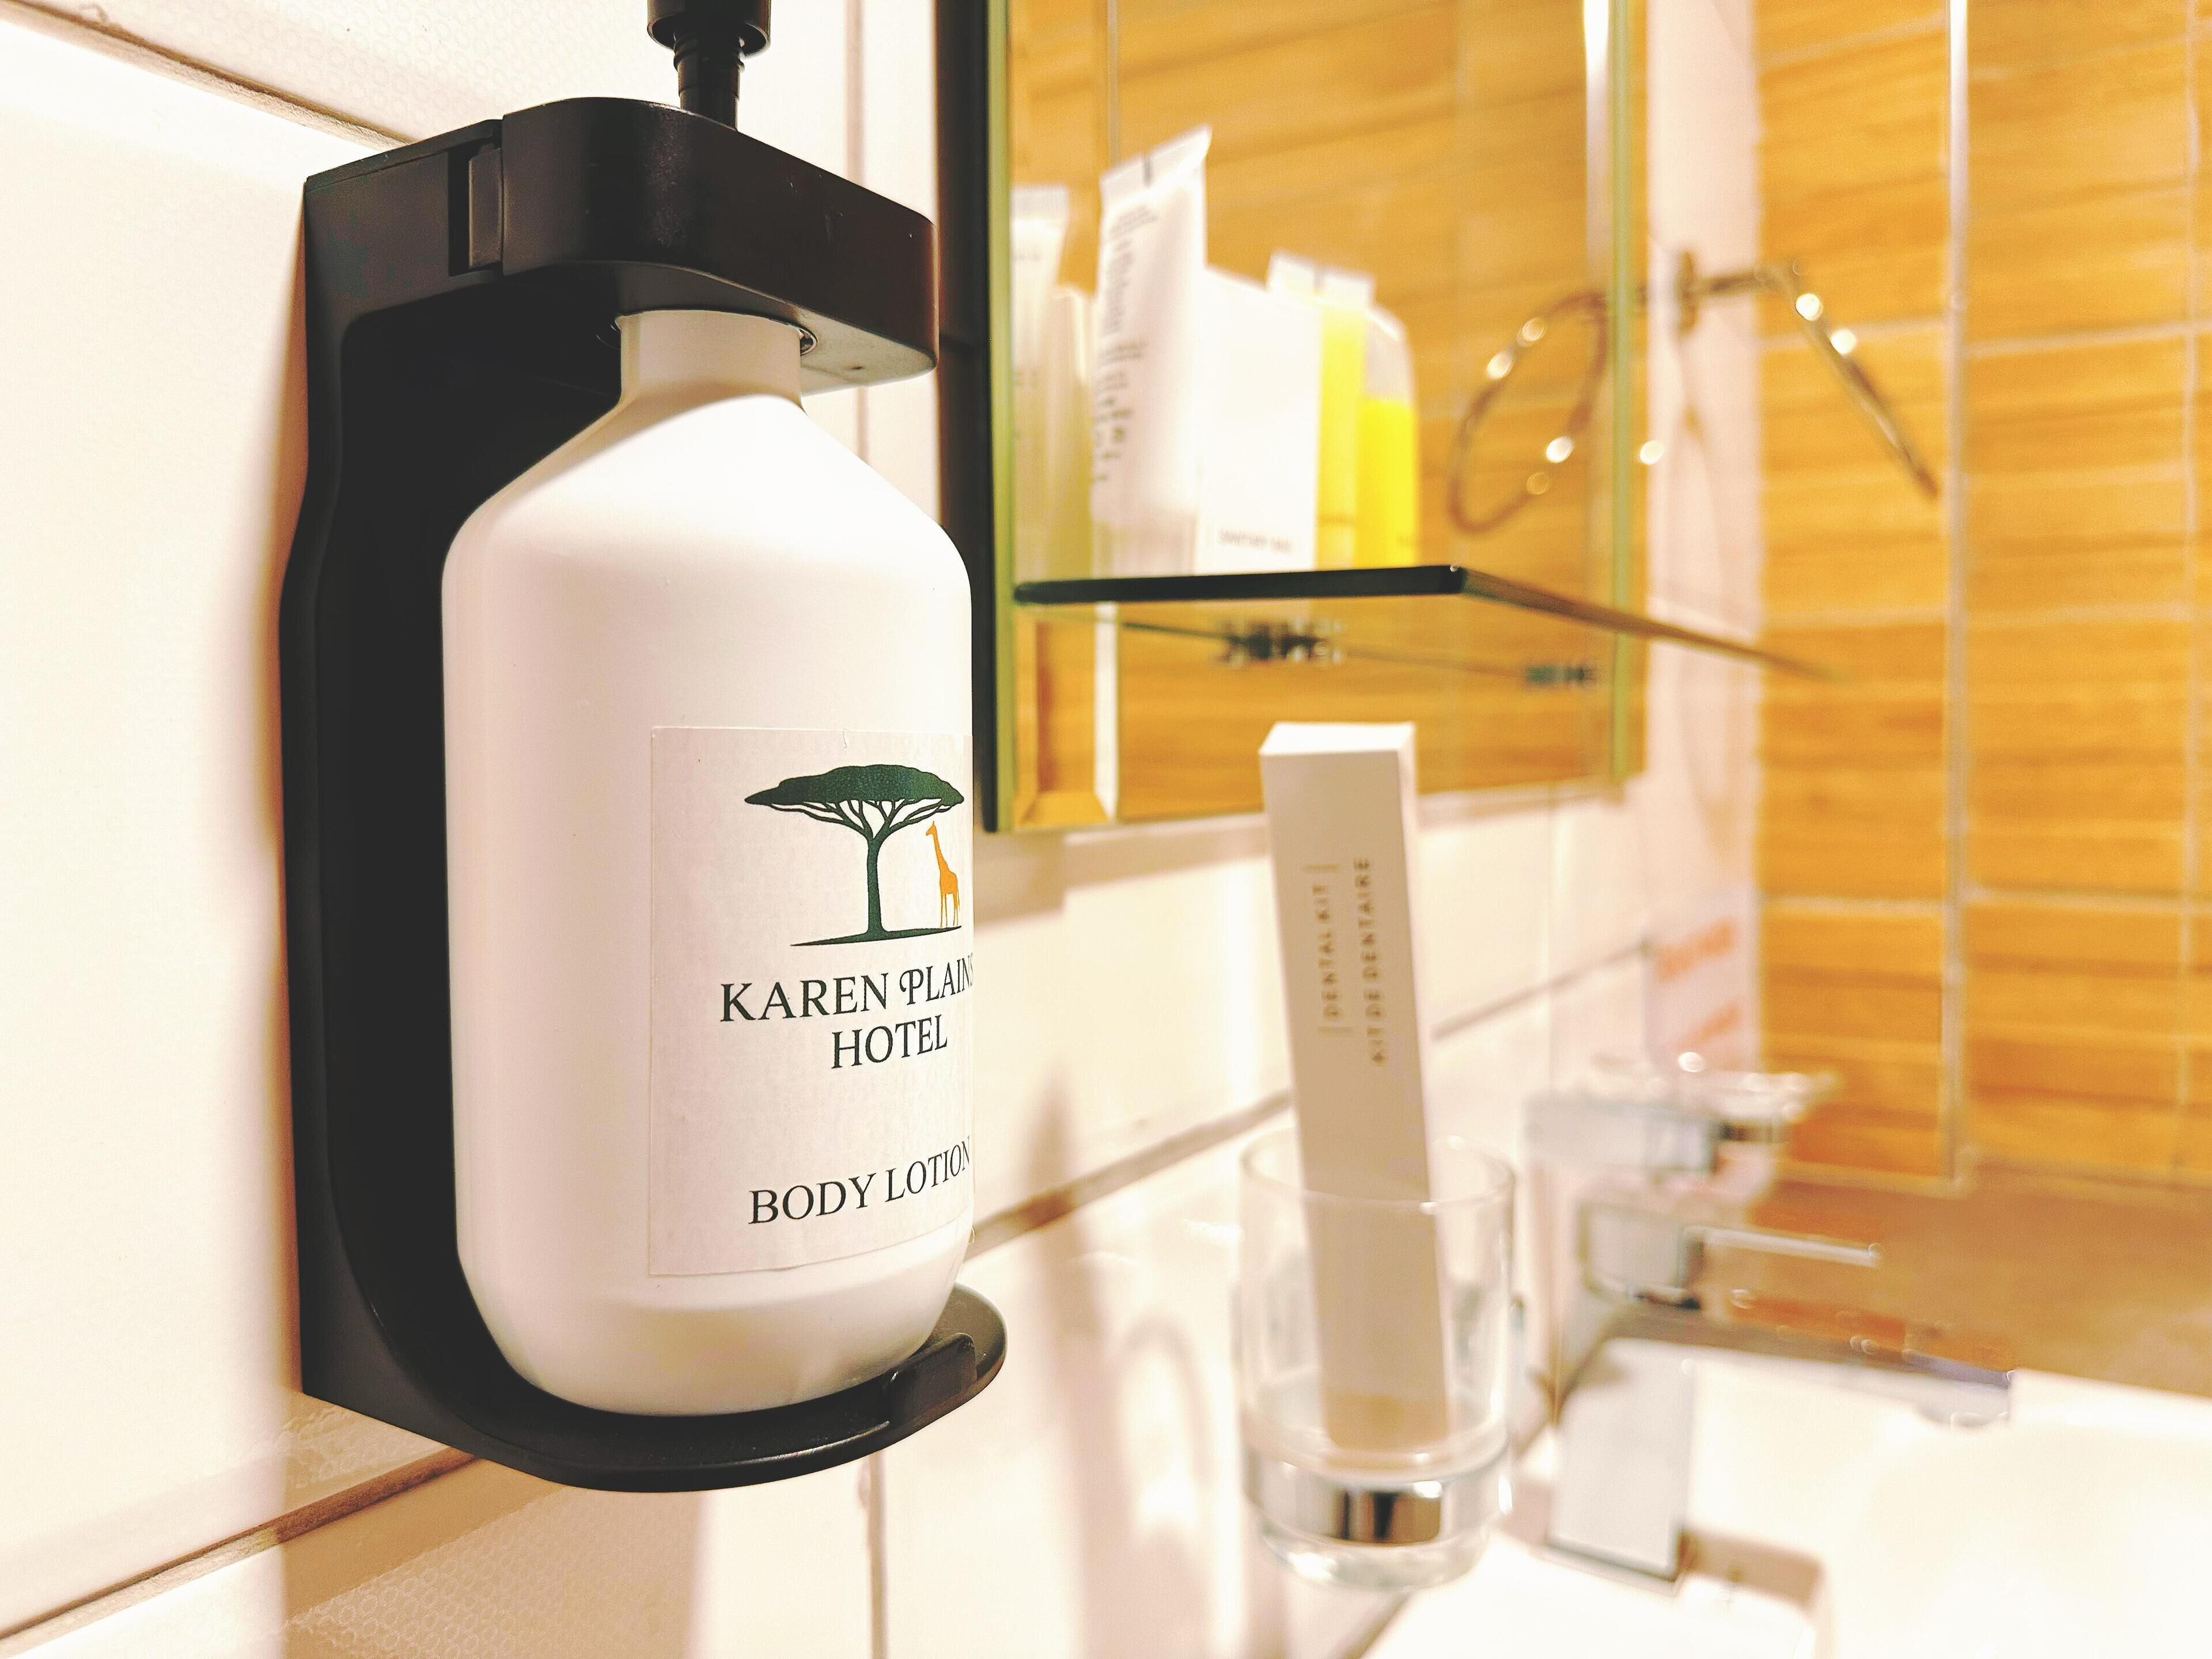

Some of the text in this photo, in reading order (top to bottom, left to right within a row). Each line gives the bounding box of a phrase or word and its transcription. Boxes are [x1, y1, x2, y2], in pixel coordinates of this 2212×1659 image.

[720, 952, 974, 1022] KAREN PLAINS
[1312, 884, 1343, 1021] DENTAL KIT
[1354, 857, 1387, 1065] KIT DE DENTAIRE
[831, 1014, 948, 1069] HOTEL
[748, 1135, 970, 1225] BODY LOTION
